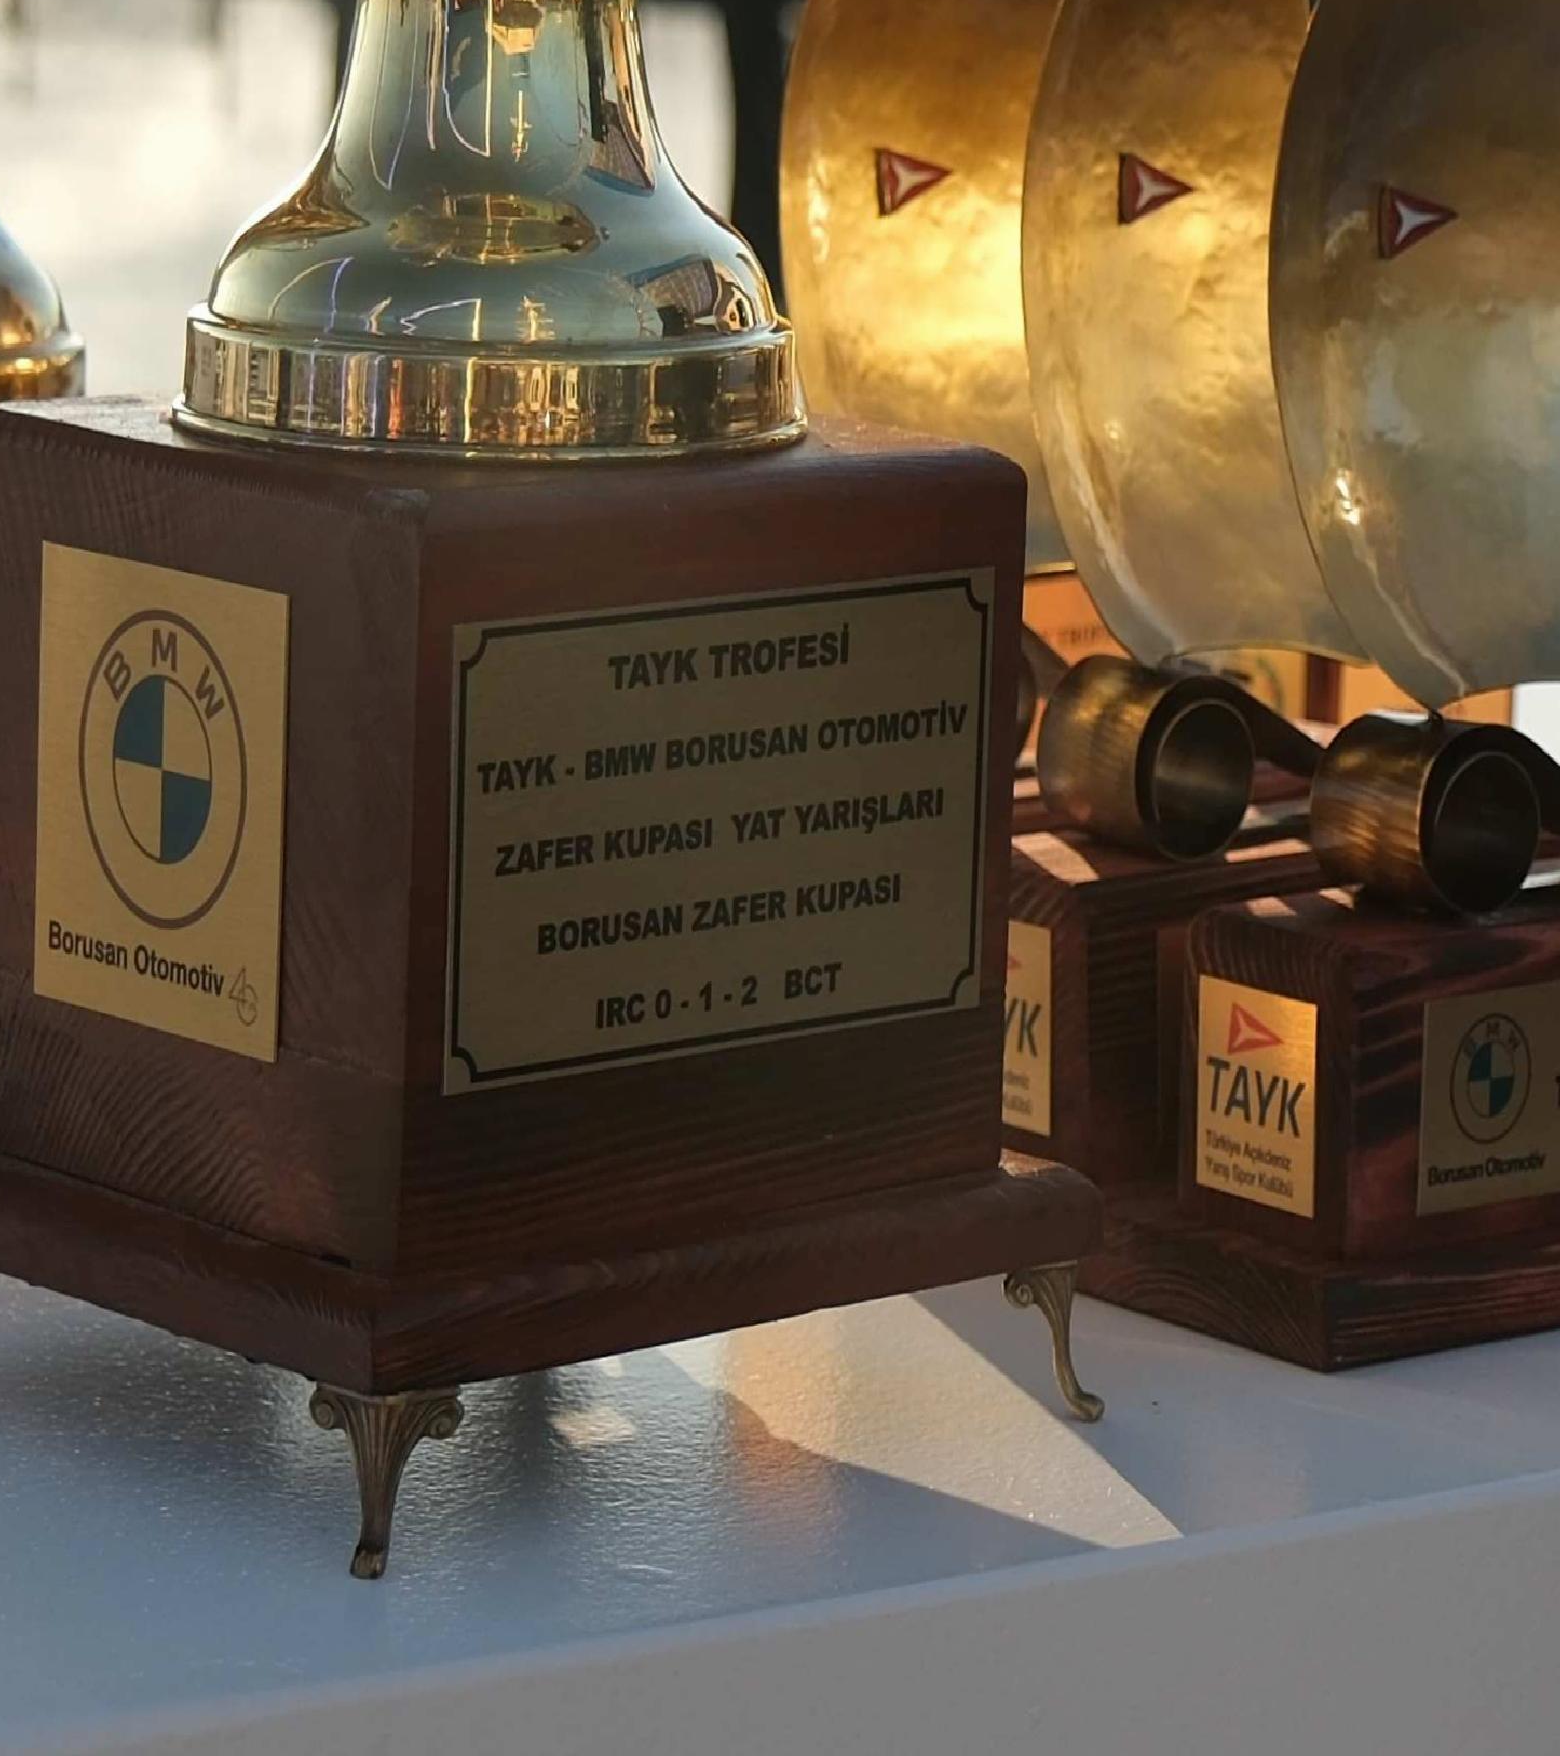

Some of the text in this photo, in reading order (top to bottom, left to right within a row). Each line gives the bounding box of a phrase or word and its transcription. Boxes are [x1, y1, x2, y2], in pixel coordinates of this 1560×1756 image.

[103, 628, 224, 720] BMW
[609, 622, 851, 691] TAYK TROFESİ
[477, 755, 557, 795] TAYK
[585, 743, 657, 782] BMW
[665, 726, 808, 771] BORUSAN
[818, 700, 968, 751] OTOMOTİV
[495, 787, 944, 877] ZAFER KUPASI YAT YARIŞLARI
[537, 873, 901, 955] BORUSAN ZAFER KUPASI
[48, 920, 224, 997] Borusan Otomotiv
[595, 993, 646, 1029] IRC
[699, 982, 714, 1014] 1
[741, 976, 758, 1006] 2
[784, 963, 844, 999] BCT
[1206, 1055, 1306, 1139] TAYK
[1428, 1151, 1547, 1188] Borusan Otomotiv
